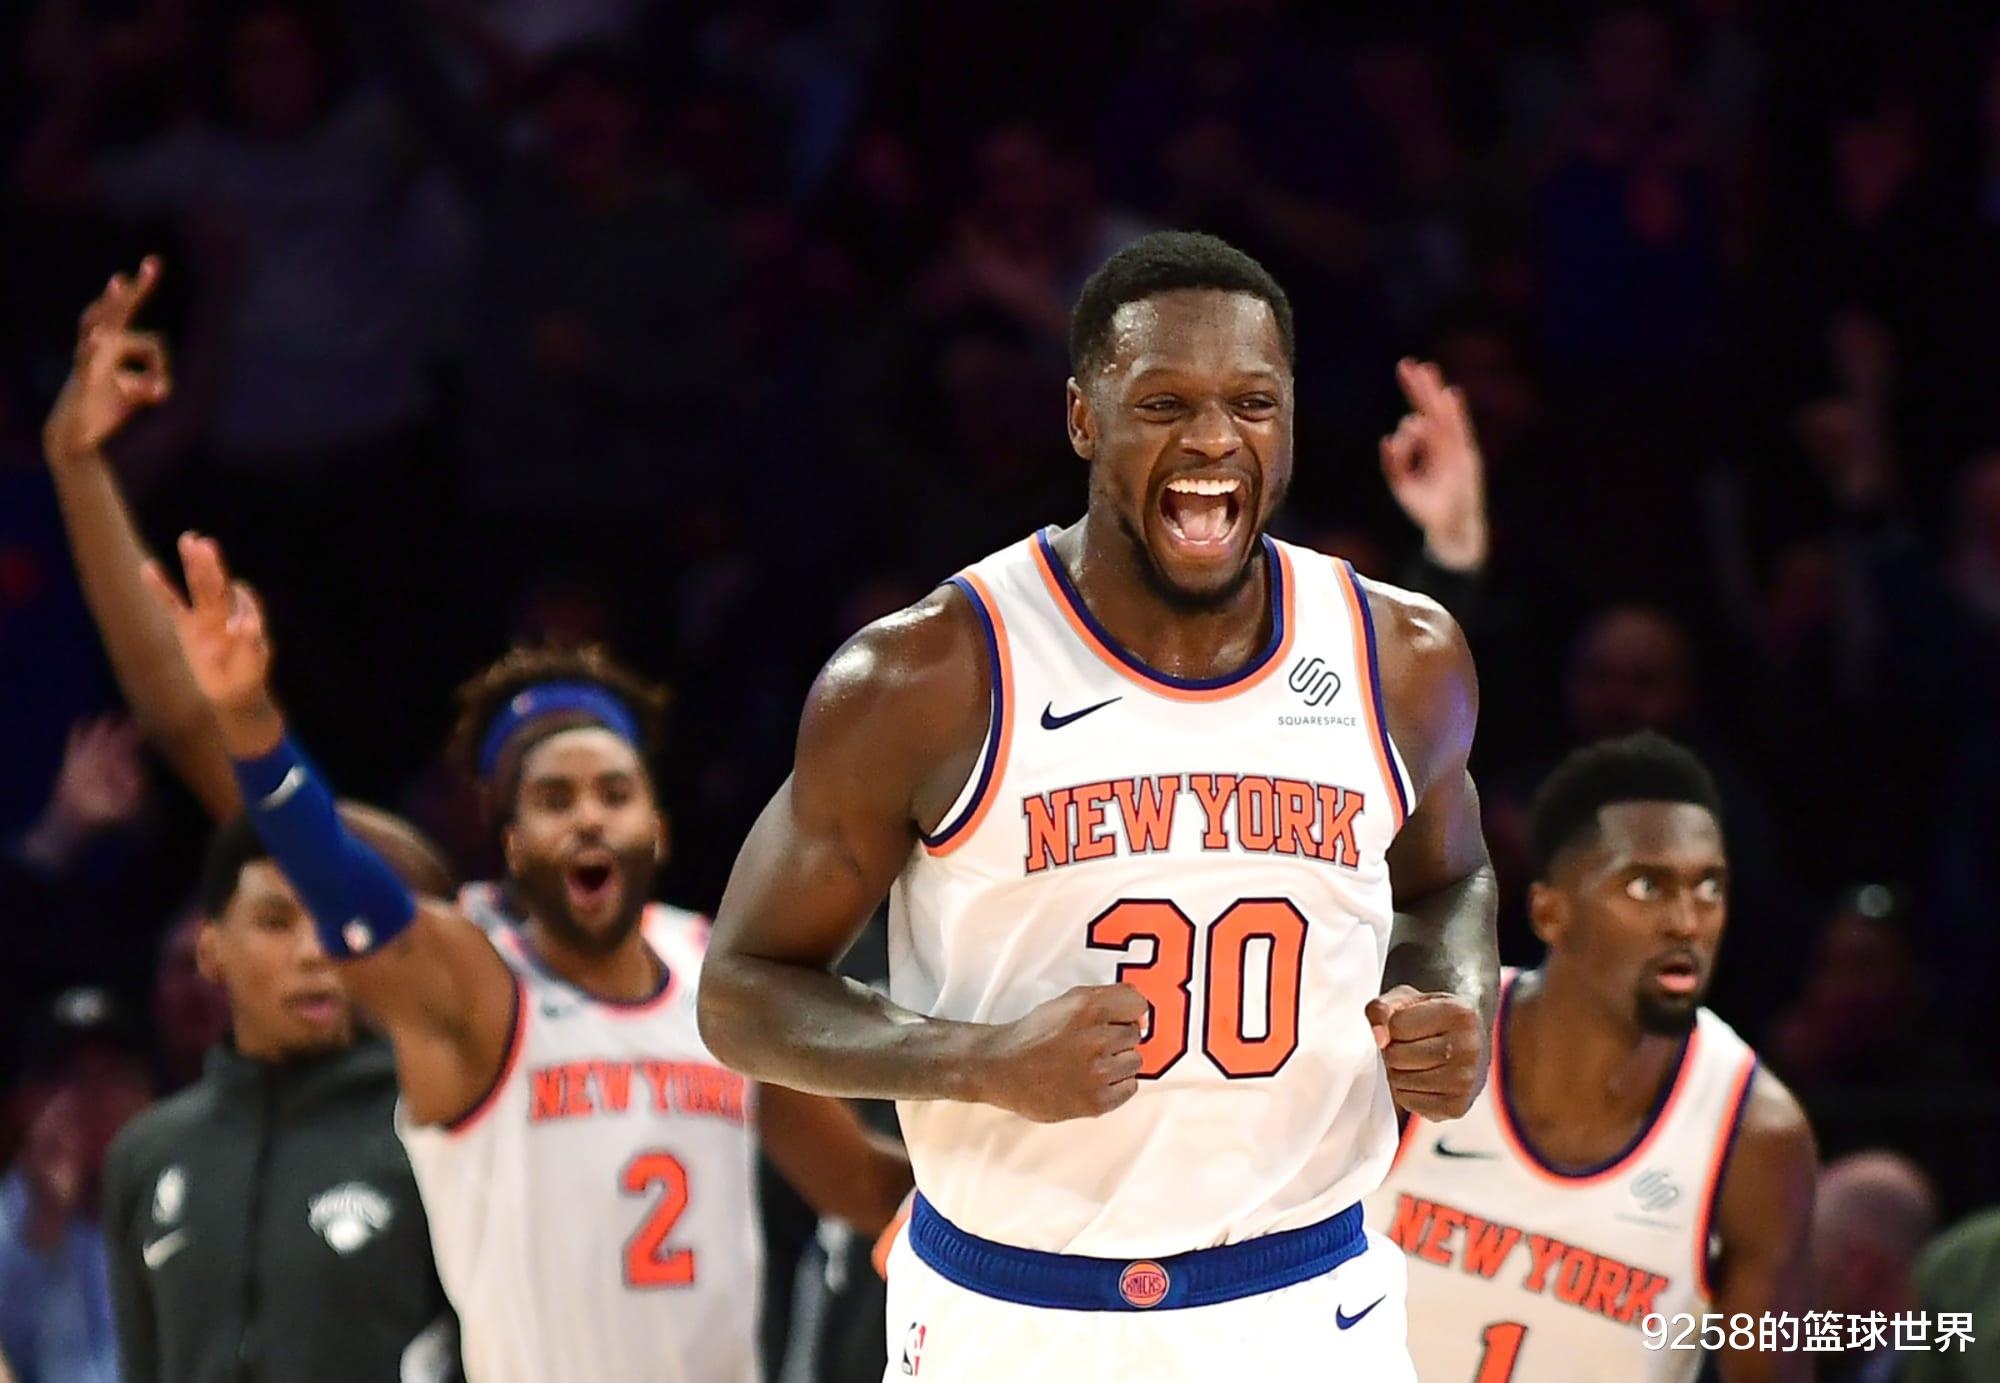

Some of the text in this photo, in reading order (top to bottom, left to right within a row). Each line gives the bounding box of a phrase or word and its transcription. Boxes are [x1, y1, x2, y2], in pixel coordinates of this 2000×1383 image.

[1278, 716, 1357, 725] SQUARESPACE
[1022, 773, 1365, 875] NEW YORK
[1085, 897, 1309, 1080] 30
[530, 1059, 633, 1123] NEW
[621, 1151, 695, 1288] 2
[1389, 1192, 1670, 1331] NEW YORK
